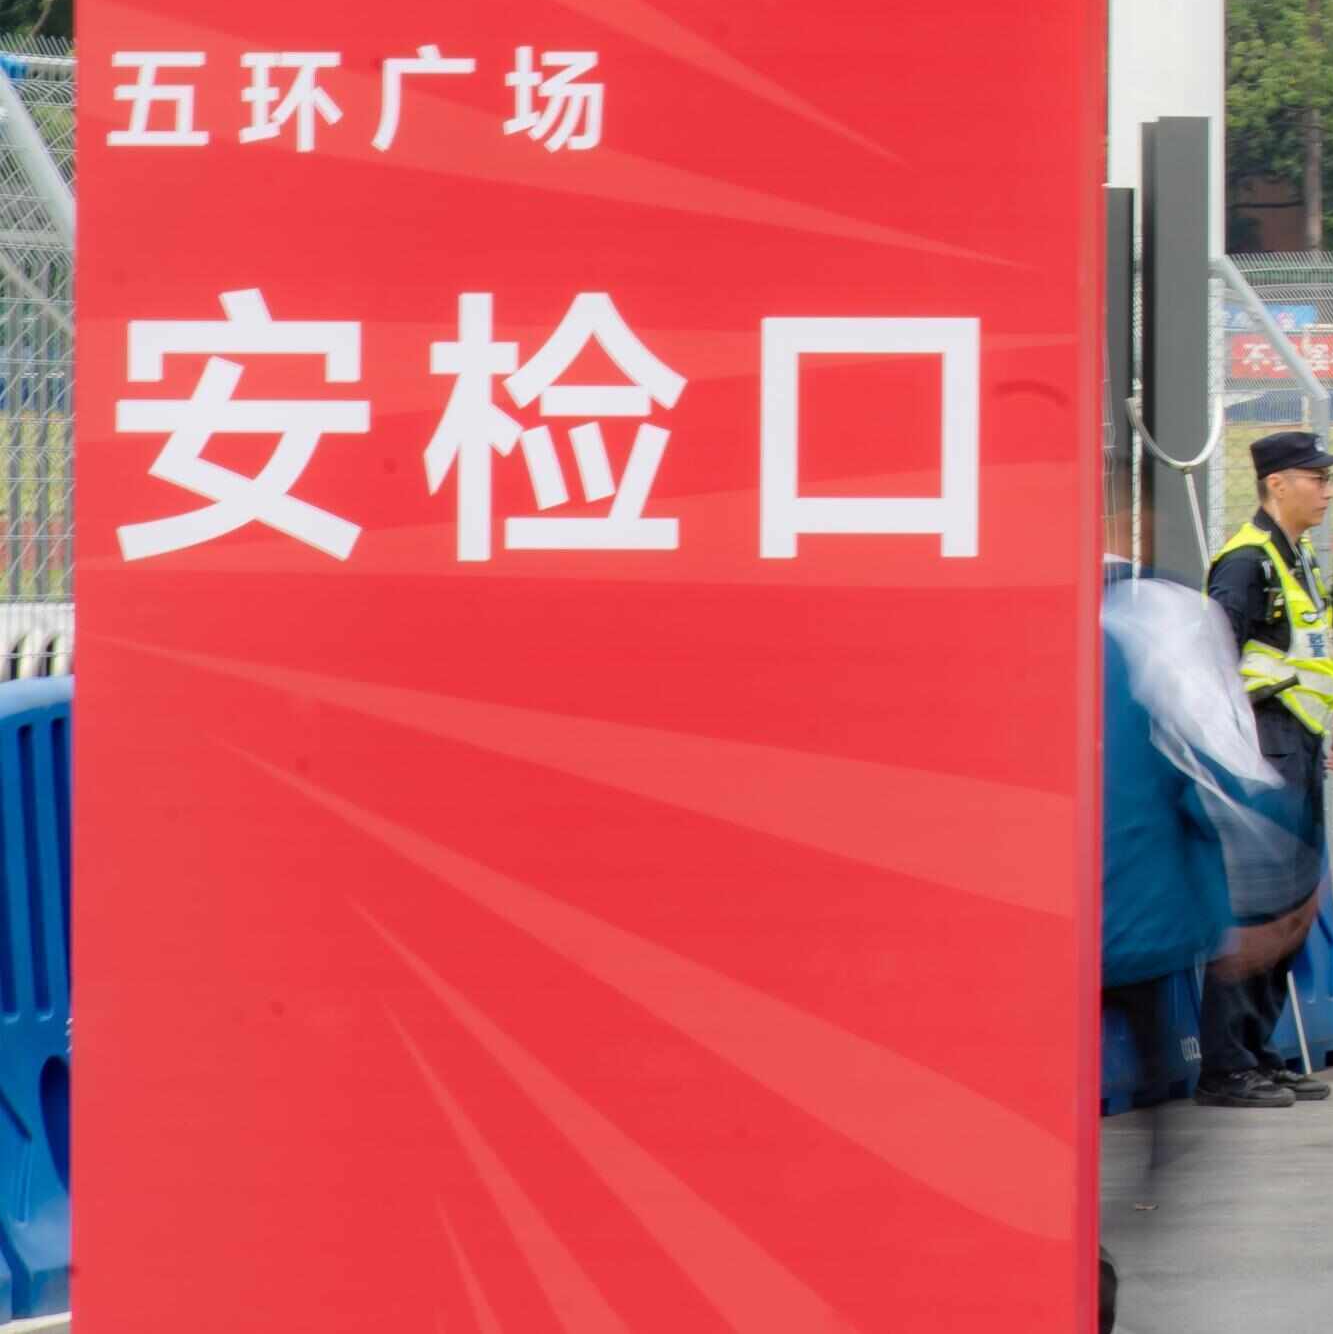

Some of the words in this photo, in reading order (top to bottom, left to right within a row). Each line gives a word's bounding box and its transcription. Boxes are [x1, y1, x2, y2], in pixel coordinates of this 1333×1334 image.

[105, 44, 606, 153] 五环广场
[115, 288, 982, 562] 安检口
